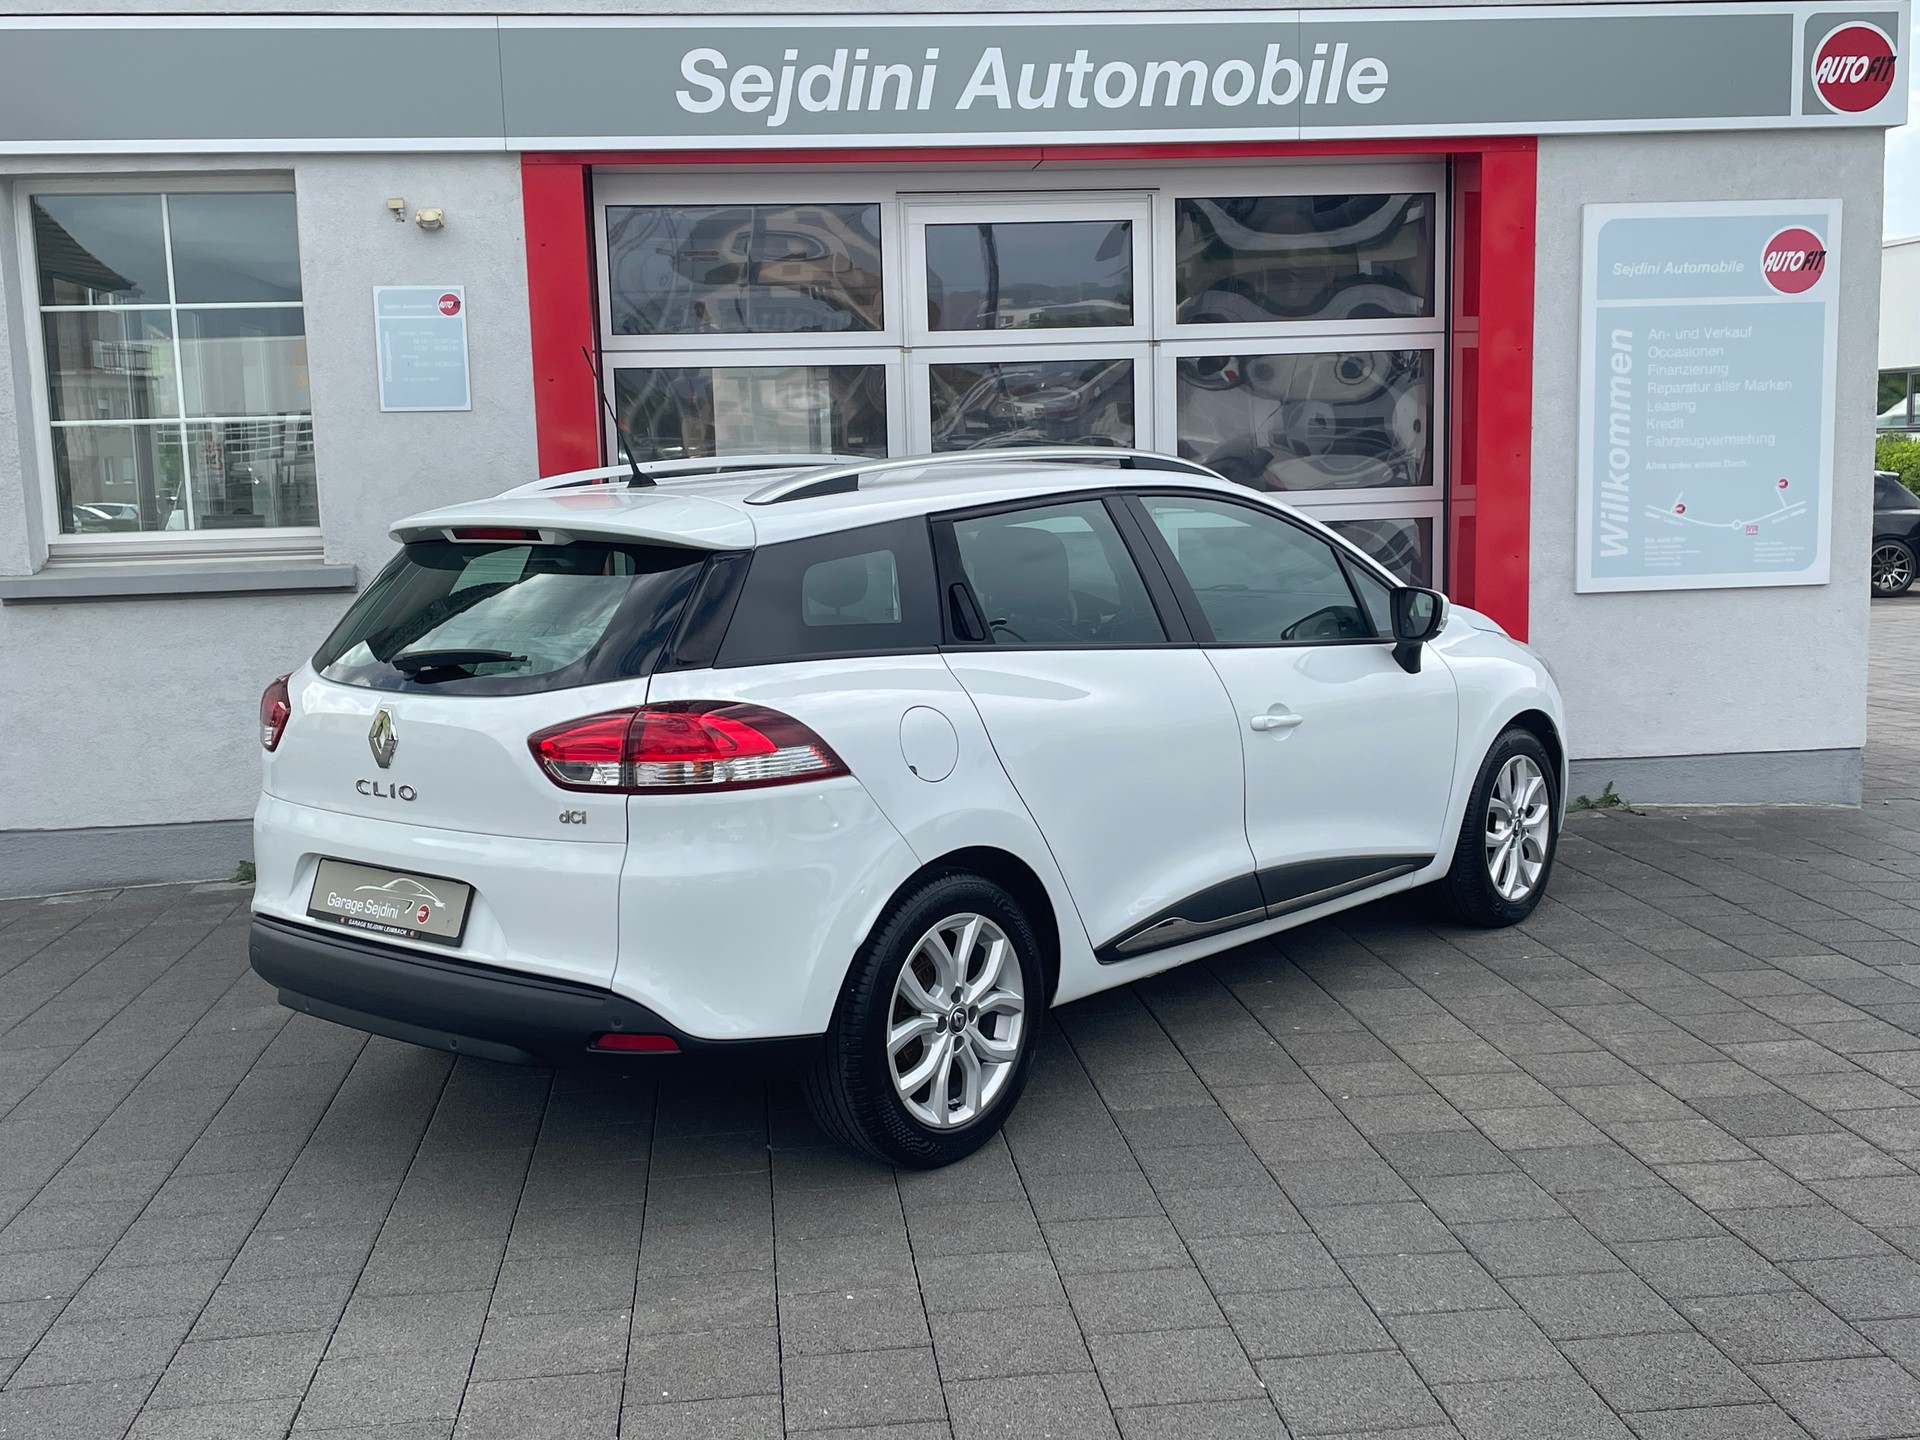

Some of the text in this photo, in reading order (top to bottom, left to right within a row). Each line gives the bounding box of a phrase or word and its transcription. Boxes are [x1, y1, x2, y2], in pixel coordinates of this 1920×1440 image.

[1815, 55, 1898, 84] AUTOFIT
[675, 42, 1390, 127] Sejdini Automobile
[1612, 260, 1745, 278] Sejdini Automobile
[1763, 250, 1827, 273] AUTOFIT
[1647, 325, 1753, 341] An- und Verkauf
[1647, 345, 1725, 359] Occasionen
[1647, 362, 1729, 378] Finanzierung
[1647, 379, 1793, 396] Reparatur aller Marken
[1646, 399, 1697, 414] Leasing
[1646, 417, 1685, 430] Kredit
[1599, 327, 1633, 558] Willkommen
[1645, 433, 1776, 449] Fahrzeugvermietung
[355, 778, 418, 803] CLIO
[327, 891, 364, 915] Garage
[364, 898, 400, 919] Sejdini
[348, 918, 367, 928] GARAGE
